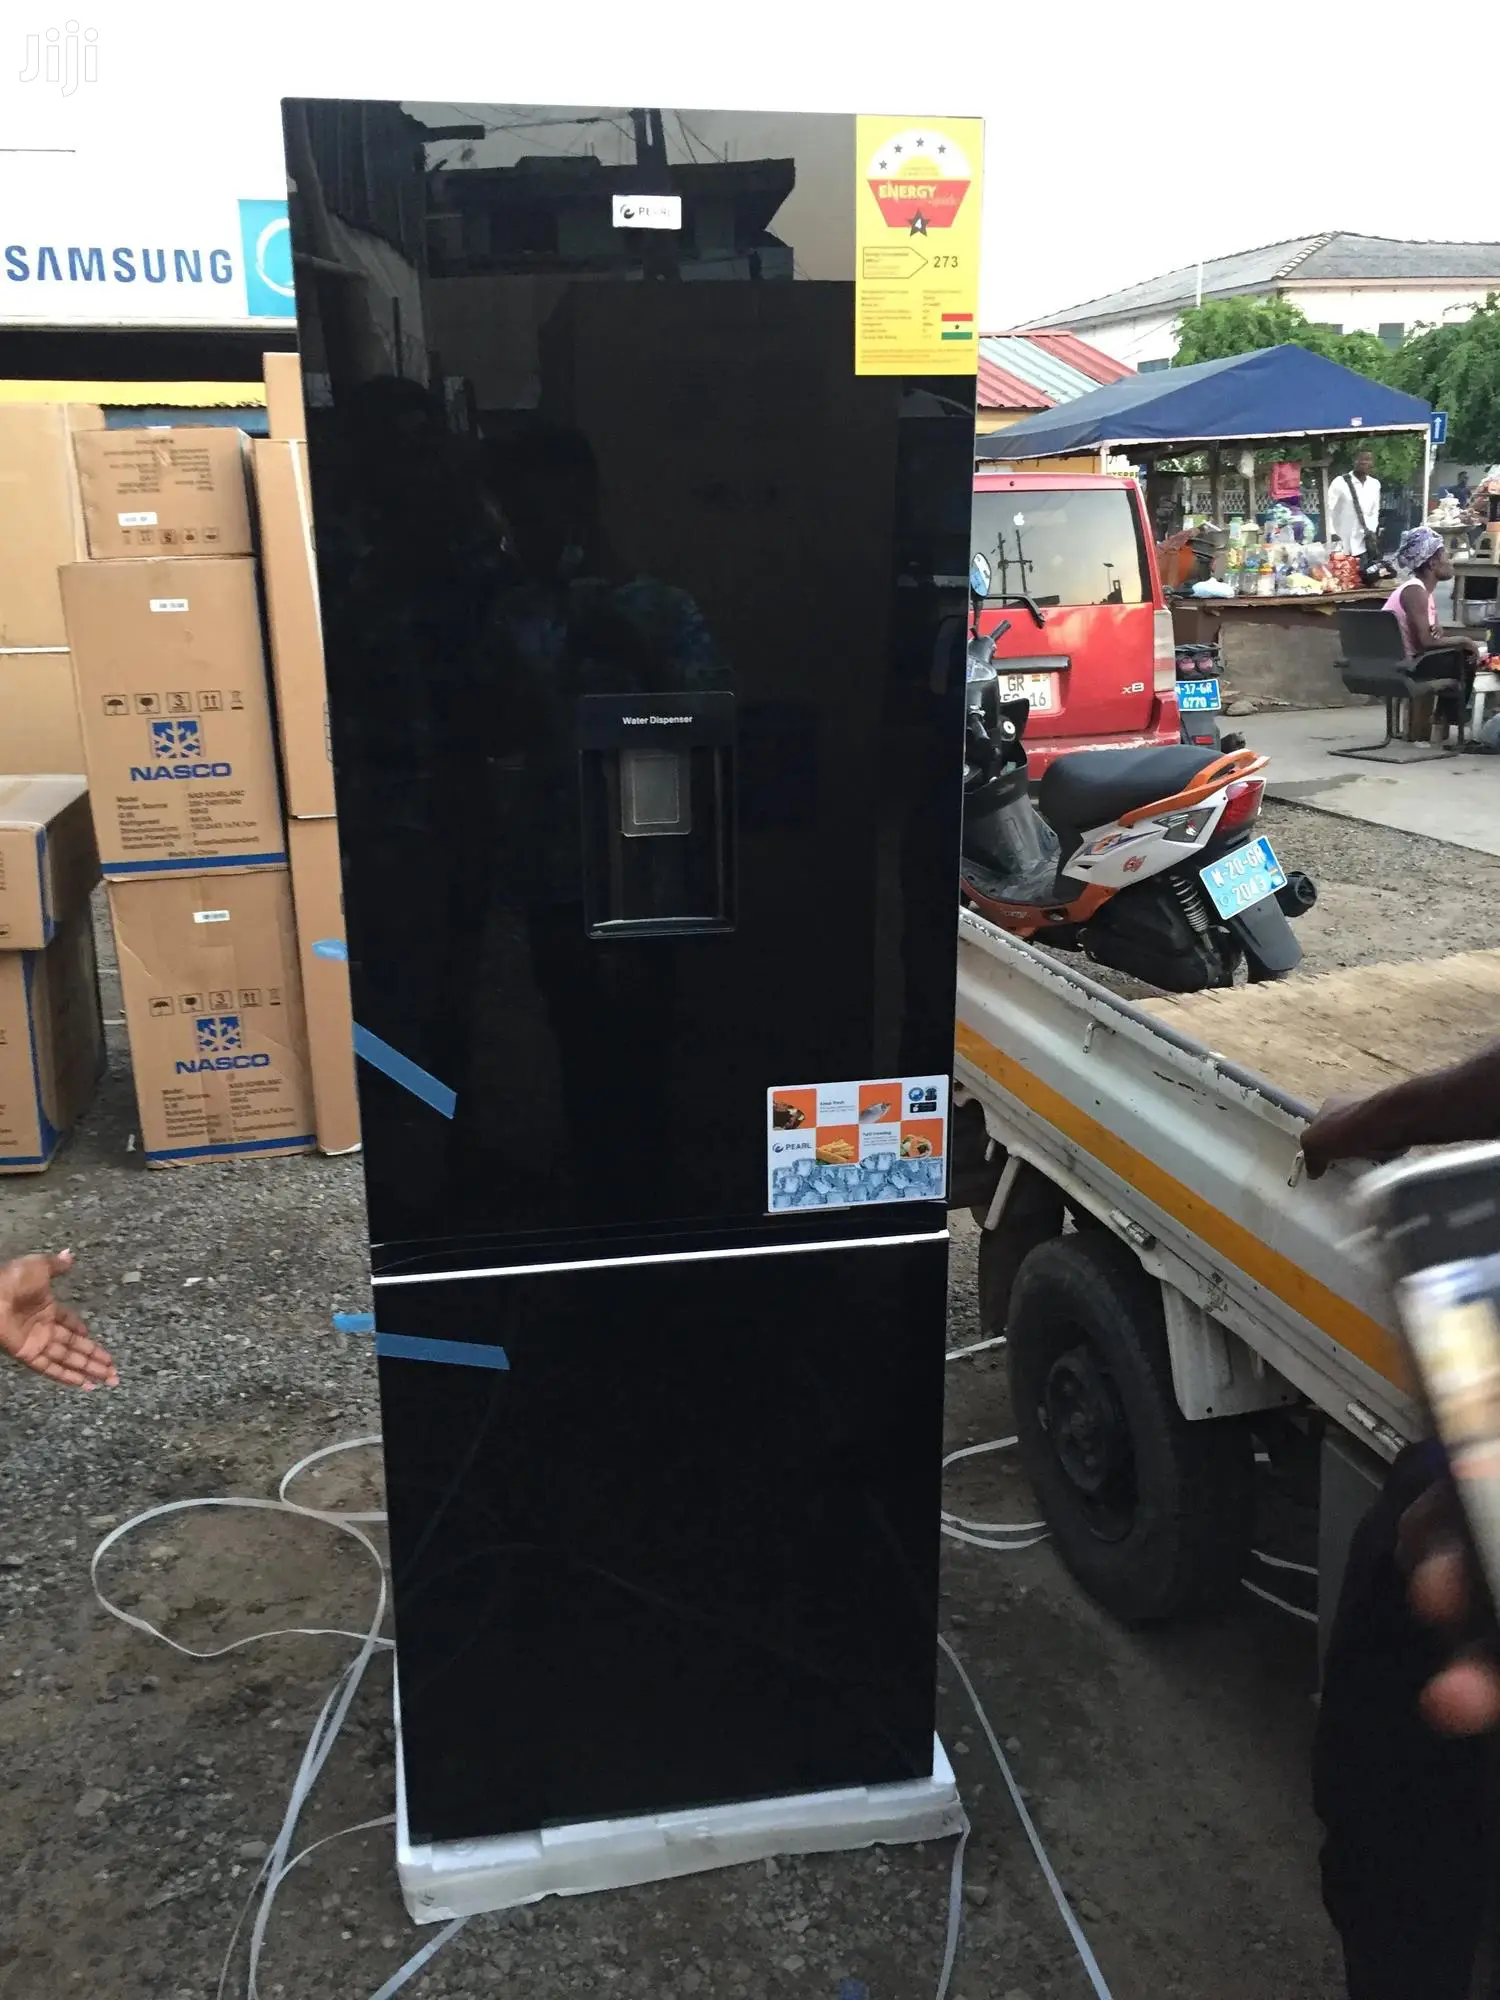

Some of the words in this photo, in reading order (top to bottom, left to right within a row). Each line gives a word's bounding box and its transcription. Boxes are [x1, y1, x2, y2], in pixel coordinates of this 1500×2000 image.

[878, 181, 937, 202] ENERGY
[914, 218, 922, 230] 4
[4, 245, 233, 284] SAMSUNG
[933, 255, 959, 269] 273
[1007, 673, 1025, 691] GR
[1121, 682, 1144, 694] xB
[1029, 692, 1047, 707] 16
[1182, 697, 1208, 708] 6770
[622, 716, 649, 725] Water
[649, 715, 693, 725] Dispenser
[130, 762, 232, 781] NASCO
[176, 1053, 270, 1074] NASCO
[785, 1142, 813, 1151] PEARL
